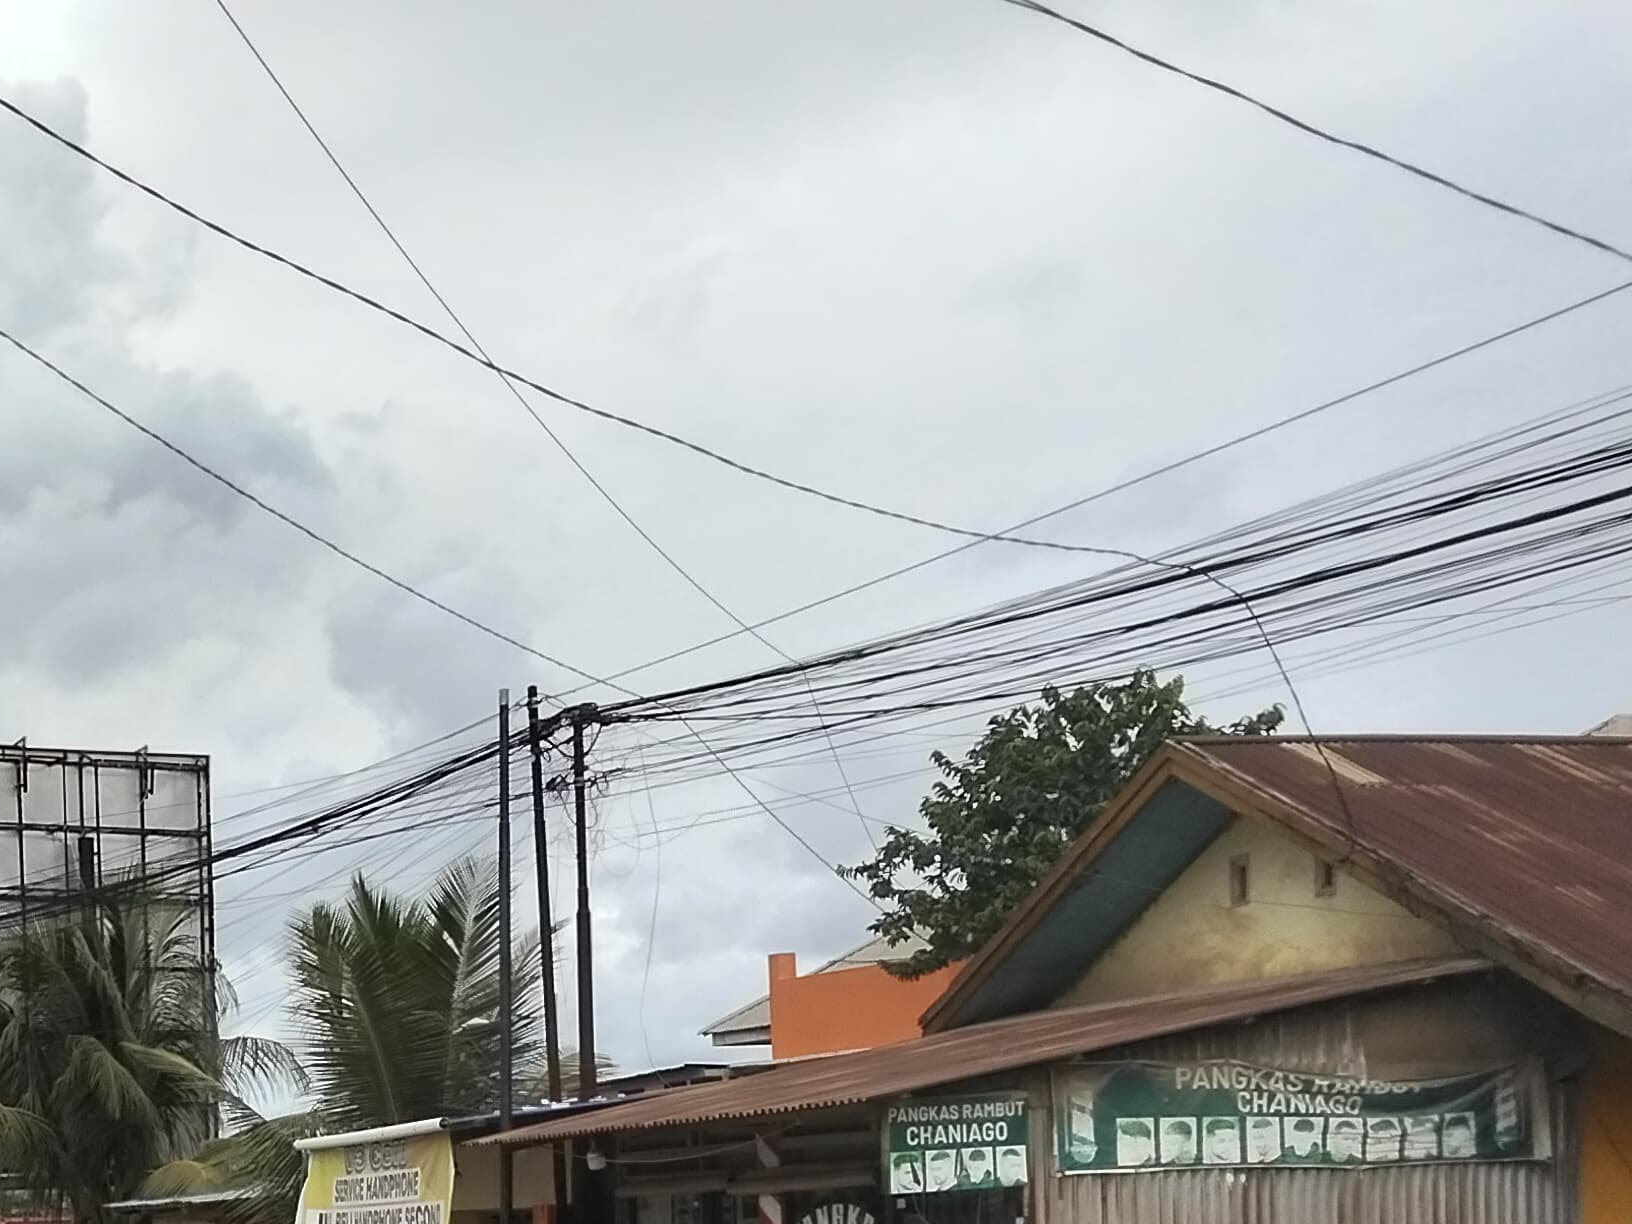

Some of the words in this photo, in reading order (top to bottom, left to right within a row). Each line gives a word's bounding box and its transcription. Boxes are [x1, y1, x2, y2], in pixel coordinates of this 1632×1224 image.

[1175, 1067, 1303, 1092] PANGKAS
[888, 1105, 959, 1123] PANGKAS
[962, 1101, 1025, 1119] RAMBUT
[1237, 1091, 1363, 1115] CHANIAGO
[906, 1121, 1008, 1145] CHANIAGO
[335, 1177, 364, 1202] SERVICE
[367, 1170, 419, 1200] HANDPHONE
